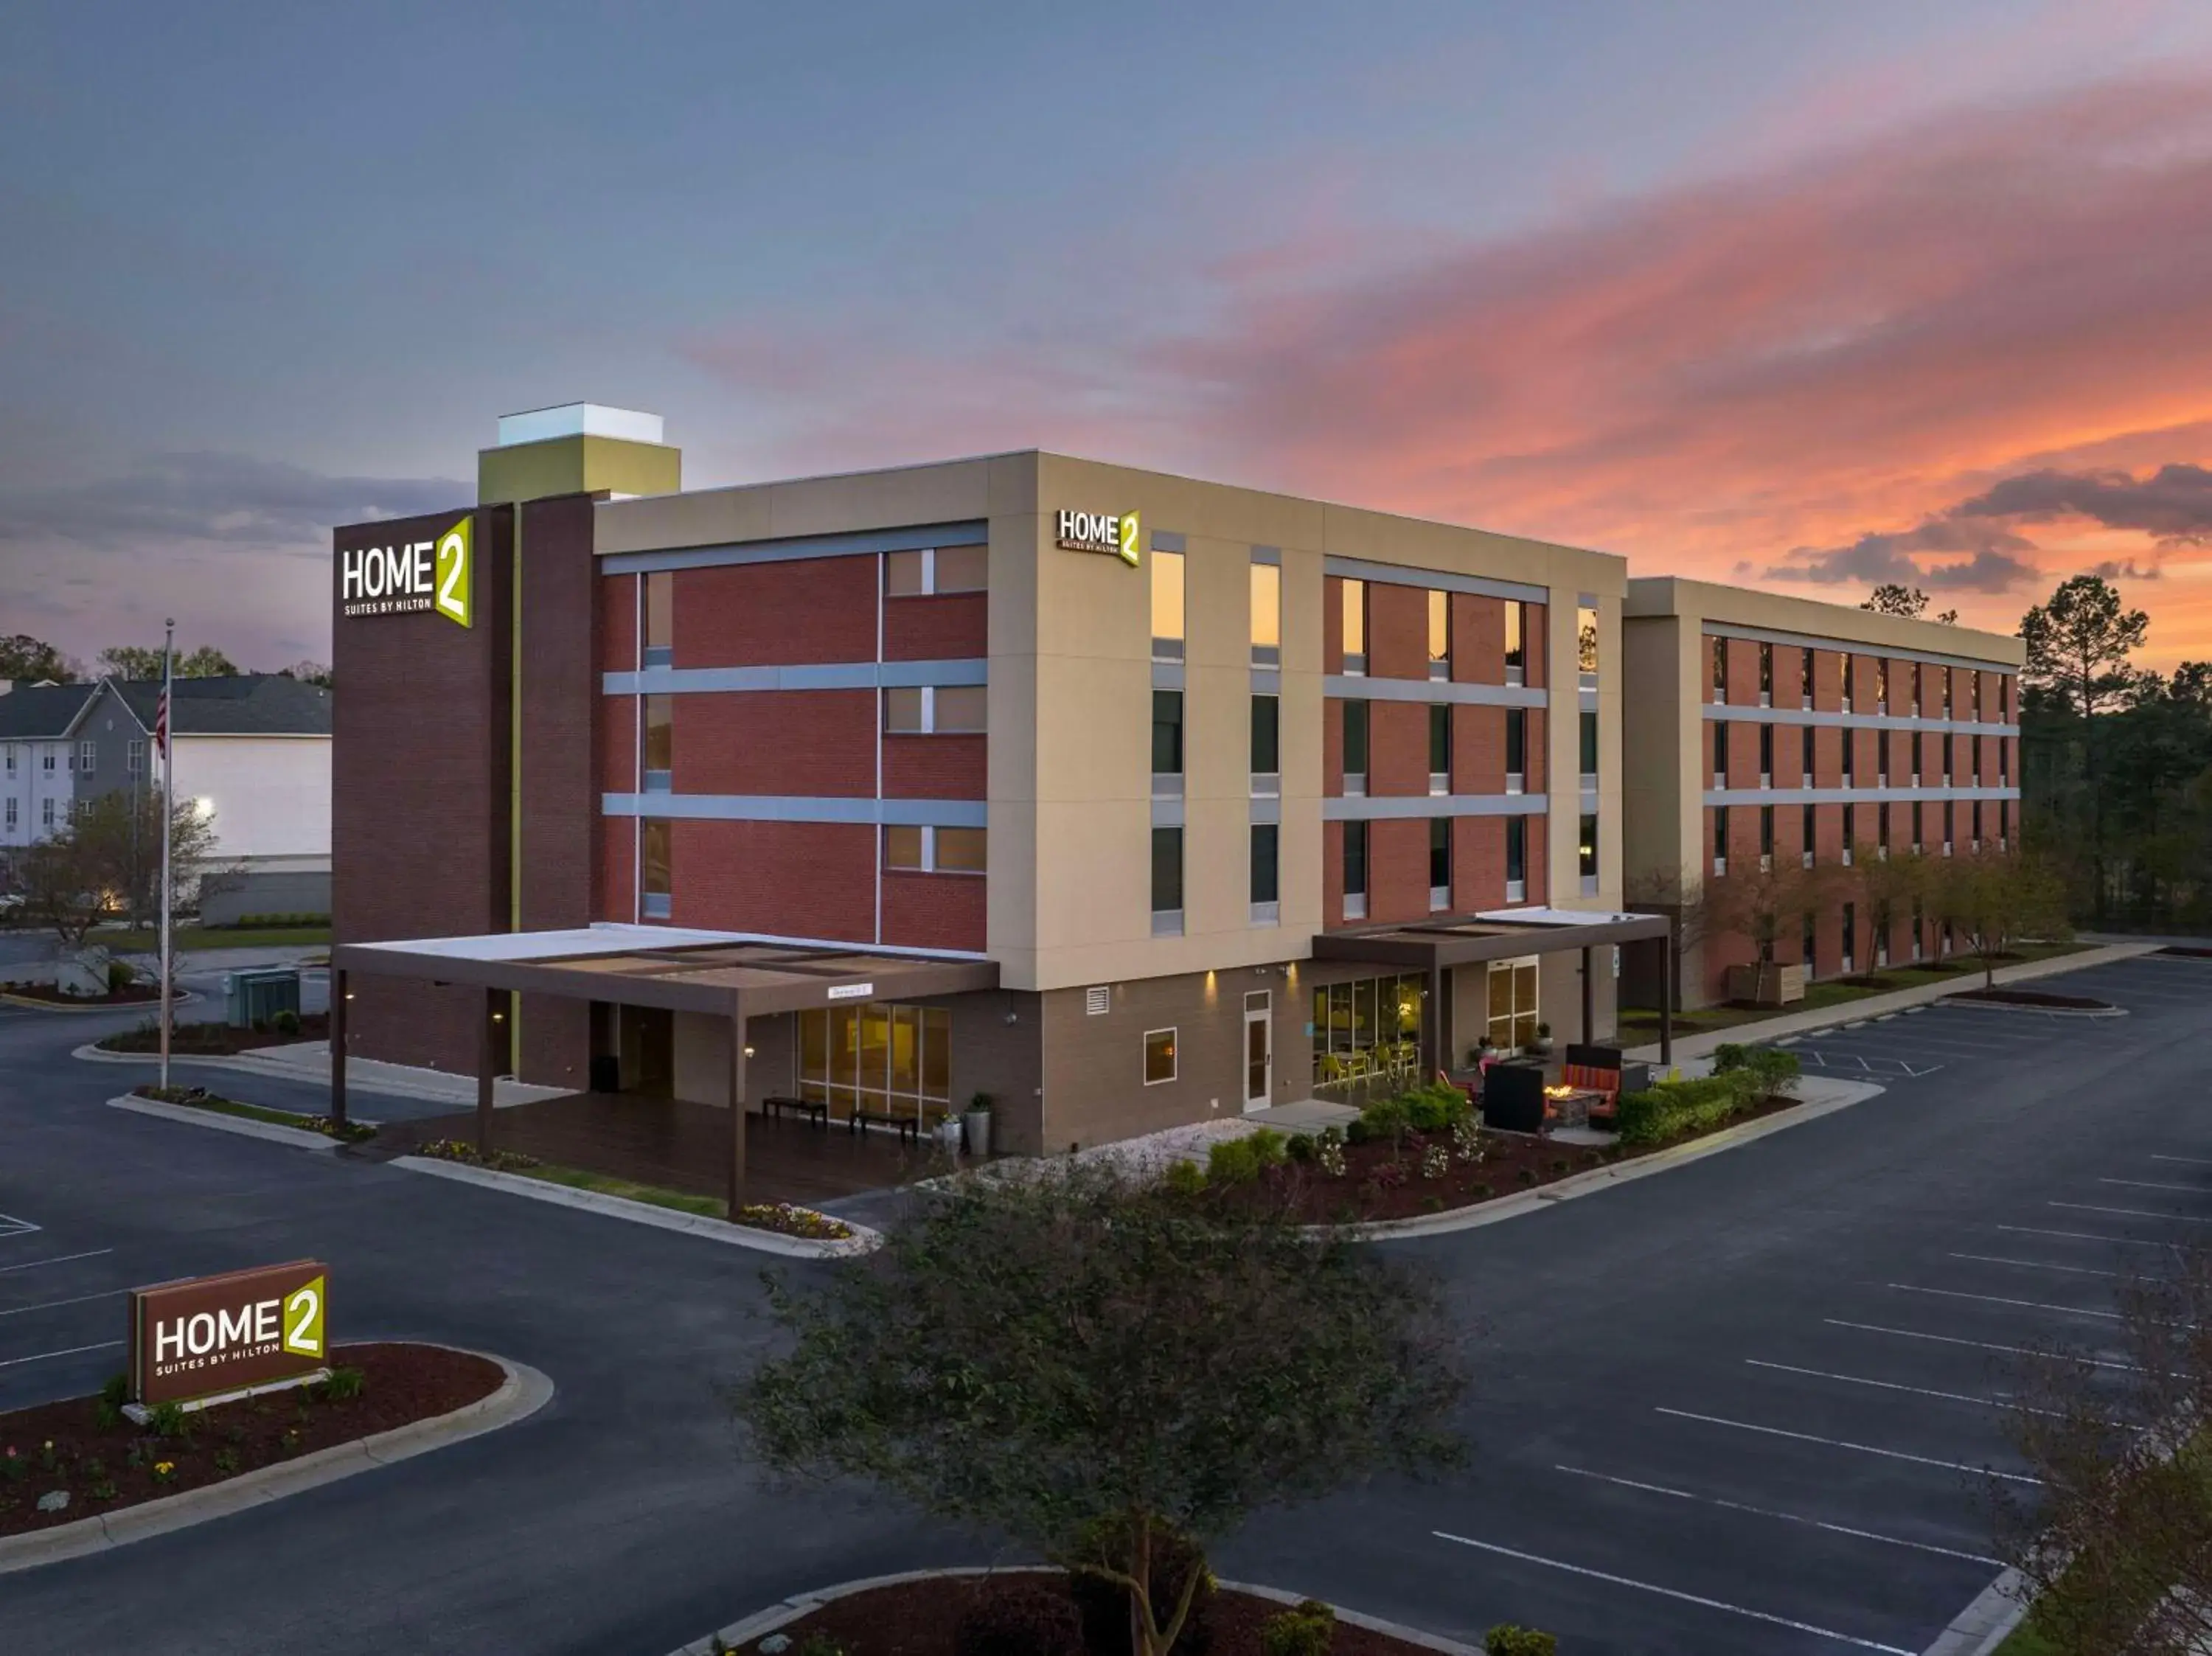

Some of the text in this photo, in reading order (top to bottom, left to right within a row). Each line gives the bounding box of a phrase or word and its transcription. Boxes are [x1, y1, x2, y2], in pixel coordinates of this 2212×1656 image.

[1060, 509, 1138, 560] HOME 2
[343, 533, 464, 617] HOME 2
[344, 598, 431, 616] SUITES BY HILTON
[156, 1290, 318, 1363] HOME 2
[156, 1343, 279, 1377] SUITES BY HILTON
